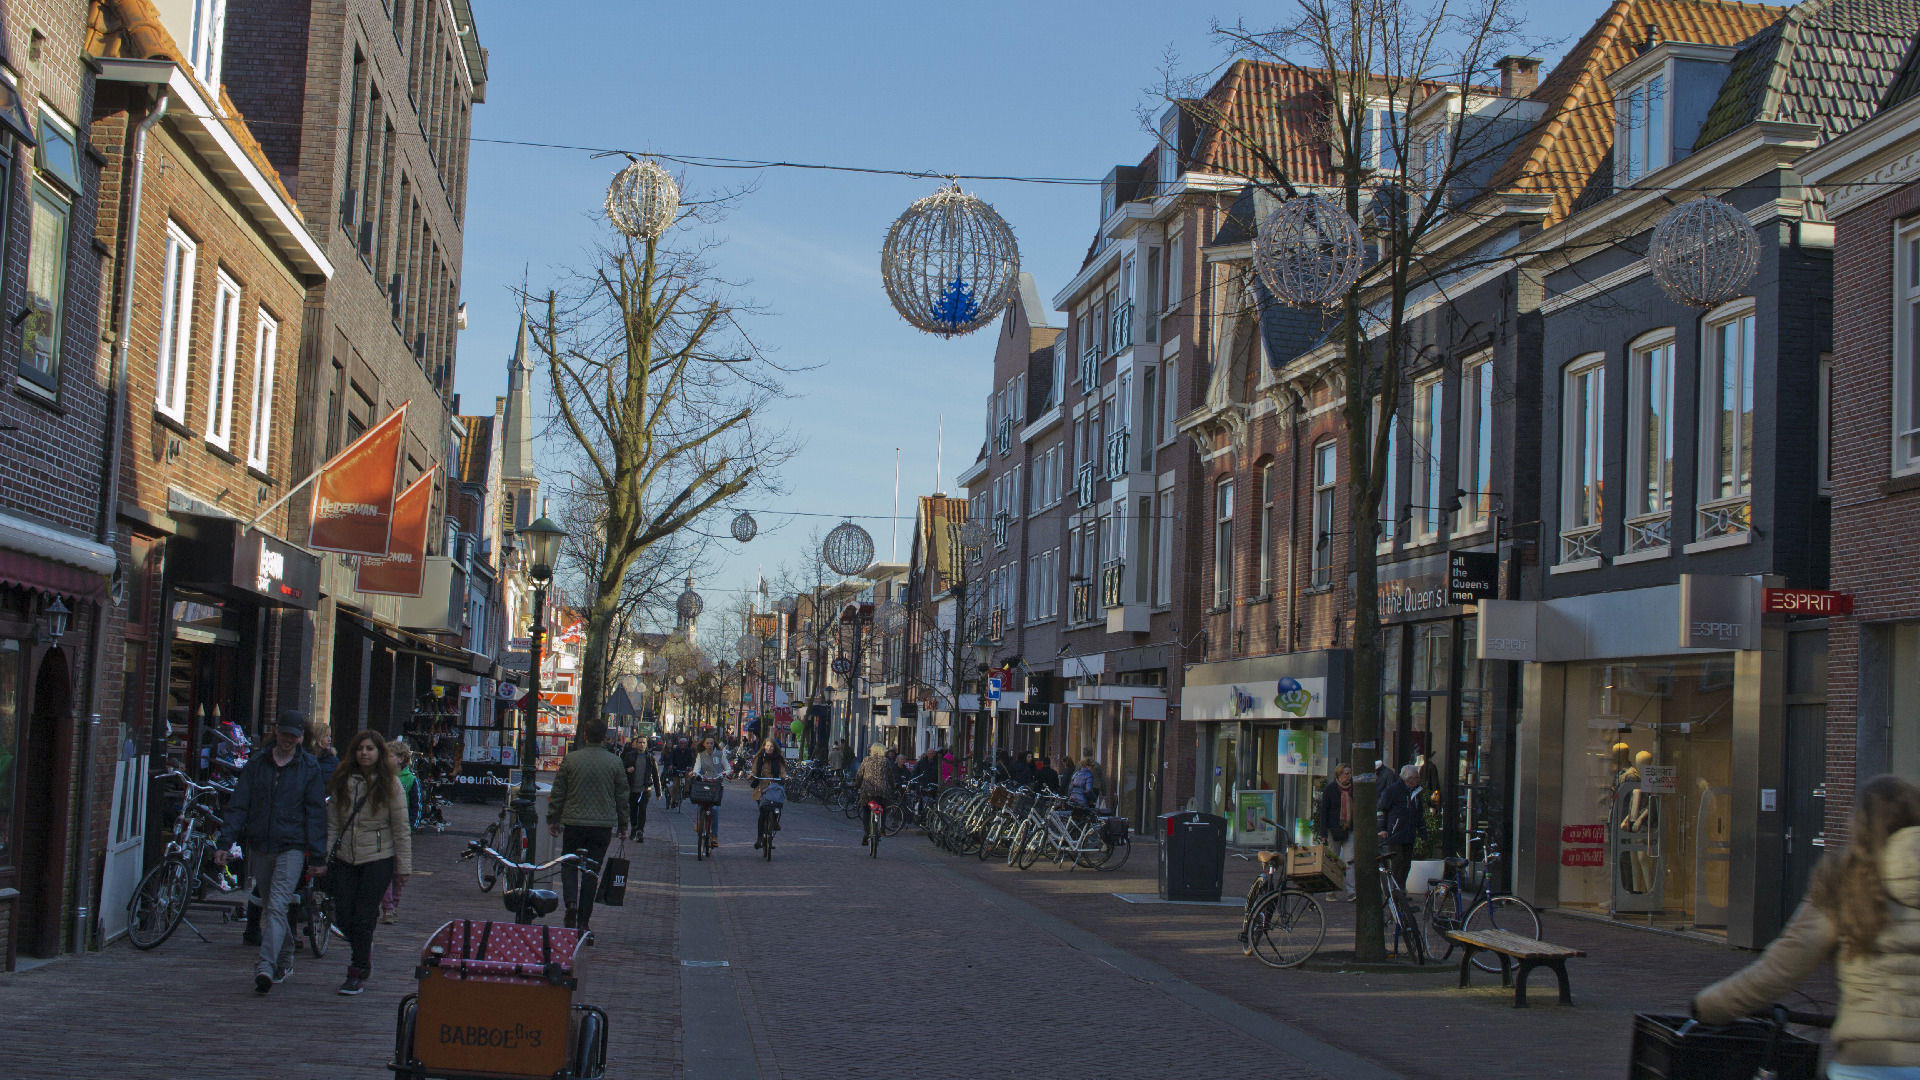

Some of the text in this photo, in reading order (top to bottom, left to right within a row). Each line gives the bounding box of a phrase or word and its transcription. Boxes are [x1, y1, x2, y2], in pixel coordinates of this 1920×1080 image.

[1452, 556, 1465, 567] all
[1452, 567, 1468, 578] the
[1452, 578, 1489, 590] Queen's
[1387, 591, 1402, 615] the
[1404, 585, 1442, 613] Queen's
[1452, 592, 1474, 600] men
[1771, 592, 1835, 611] ESPRIT
[1691, 621, 1742, 637] ESPRIT
[1487, 638, 1529, 651] ESPRIT
[1645, 767, 1673, 777] ESPRIT
[439, 1022, 542, 1049] BABBOE Big
